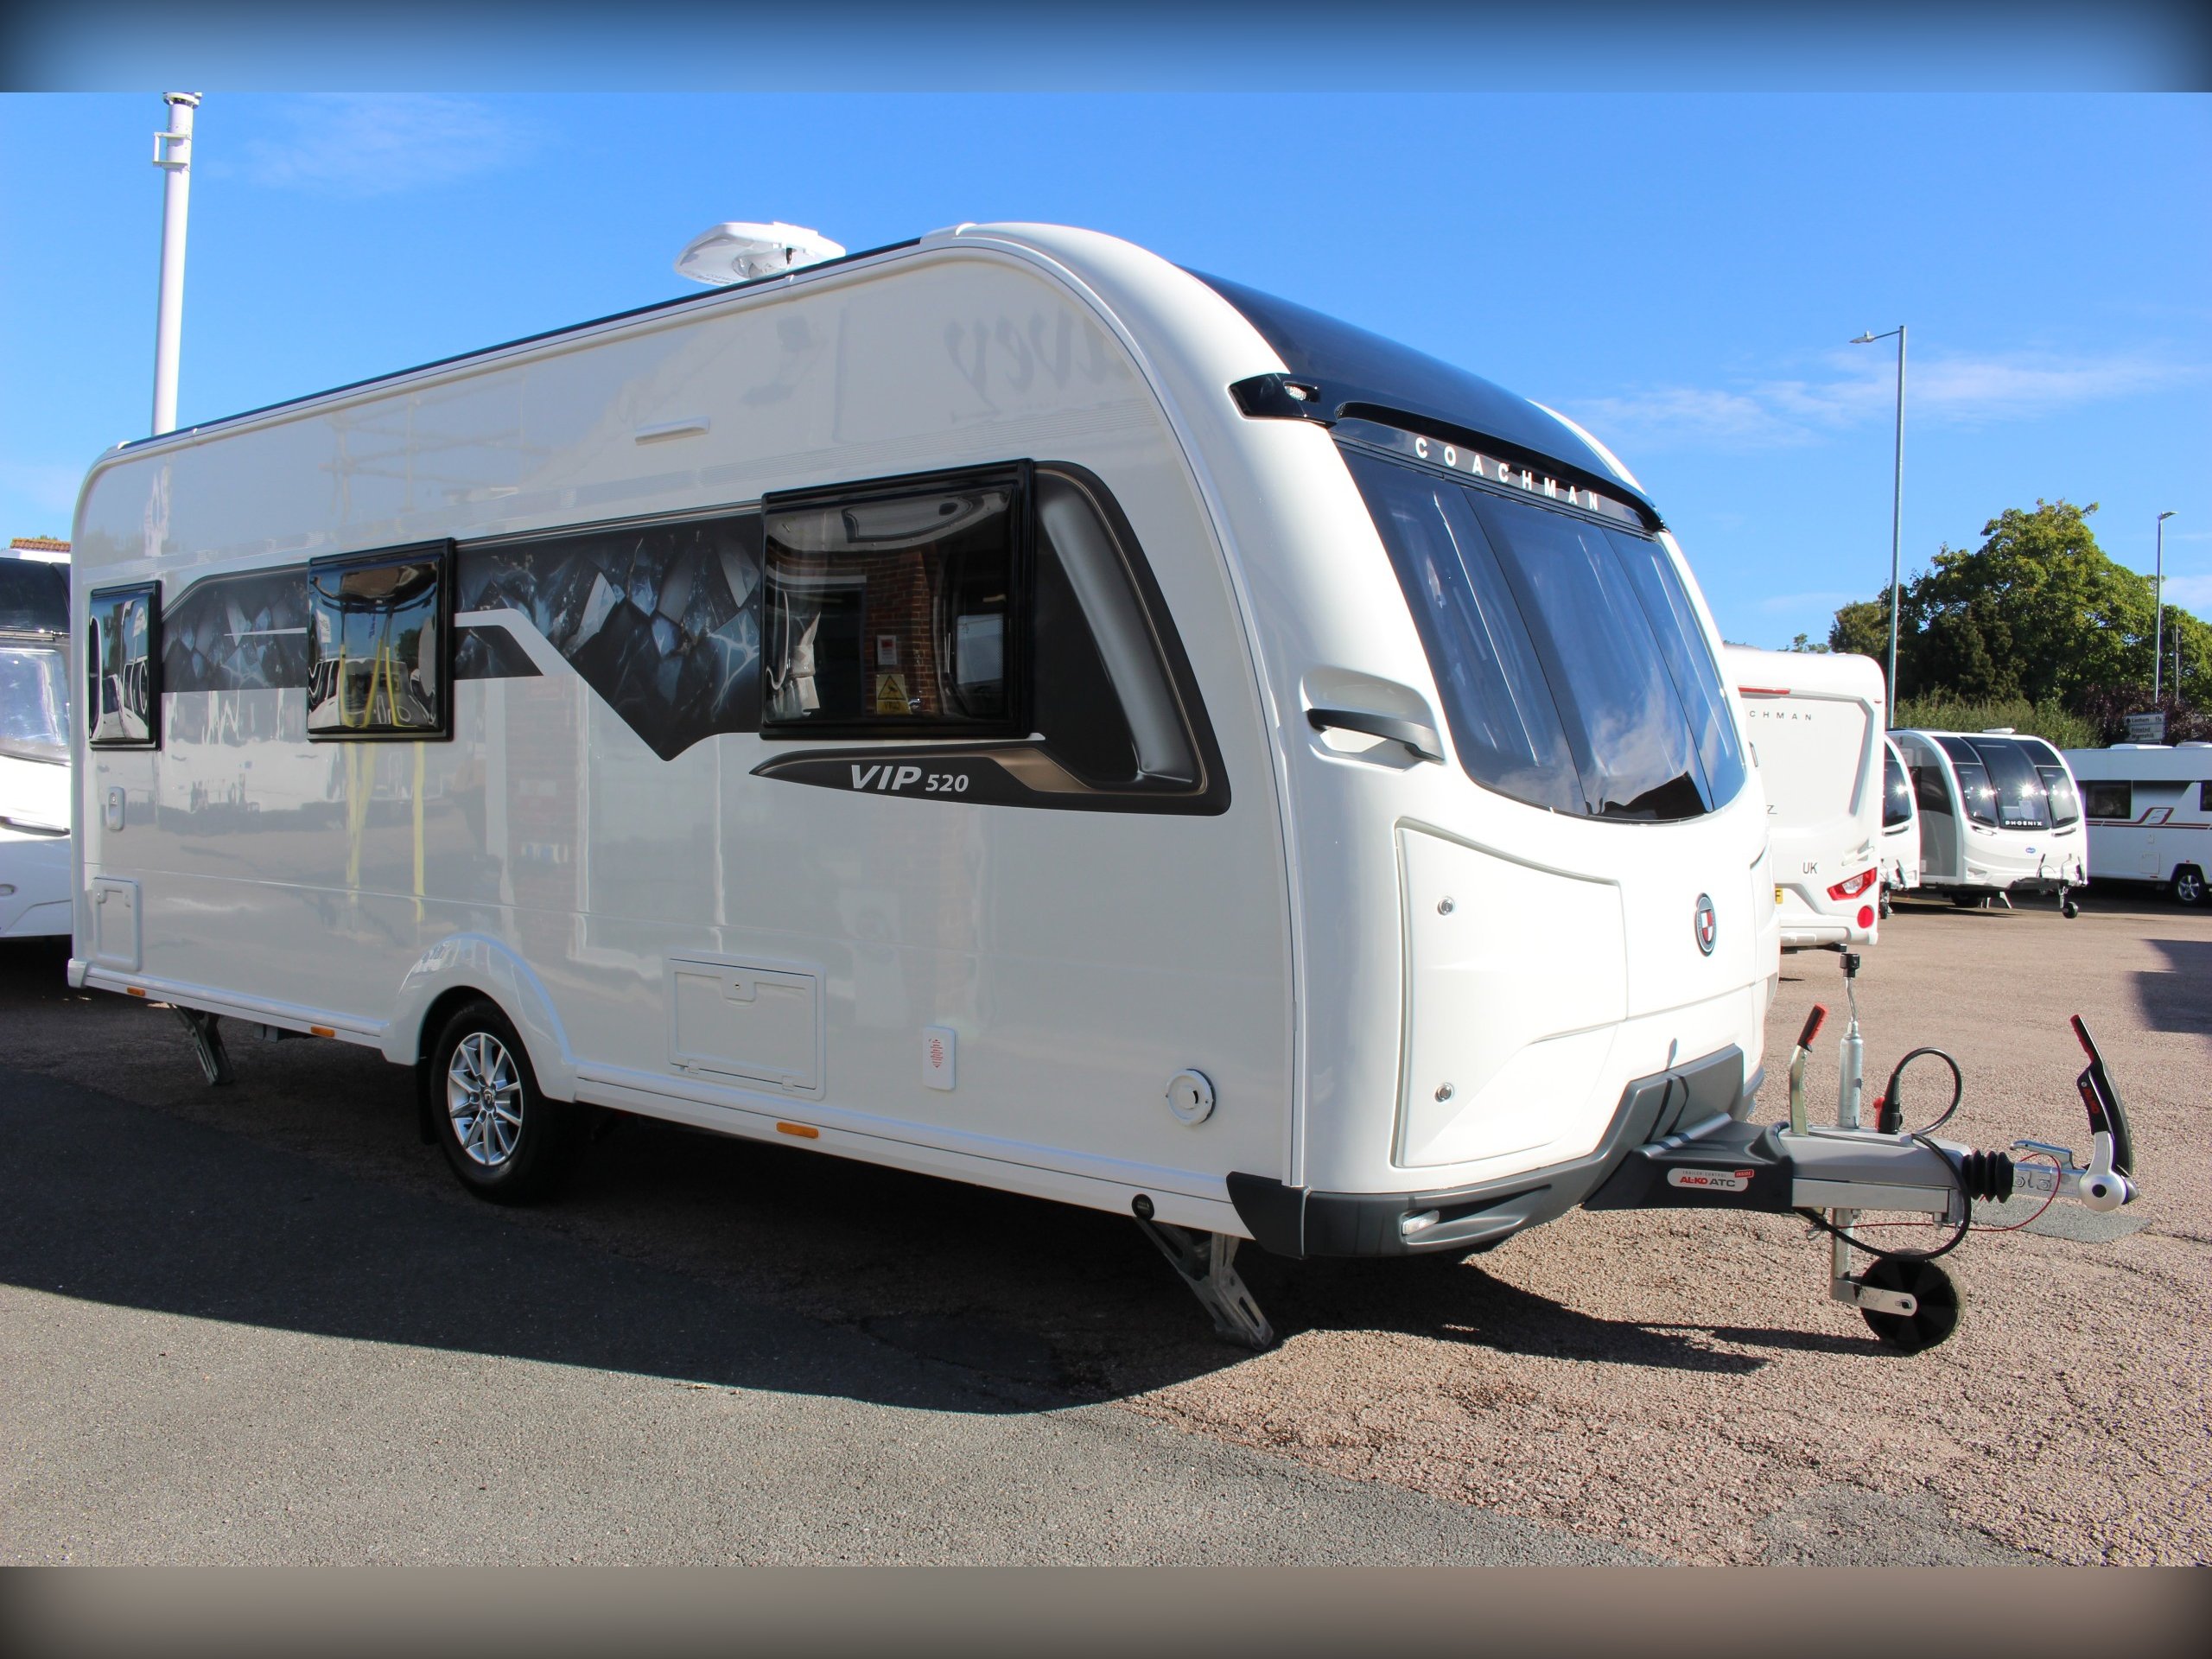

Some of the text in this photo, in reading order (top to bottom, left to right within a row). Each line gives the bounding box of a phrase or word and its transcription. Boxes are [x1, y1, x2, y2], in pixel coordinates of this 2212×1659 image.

[1415, 437, 1599, 512] COACHMAN
[851, 765, 969, 792] VIP 520
[1802, 861, 1818, 874] UK
[1680, 1176, 1736, 1187] AL-KO ATC
